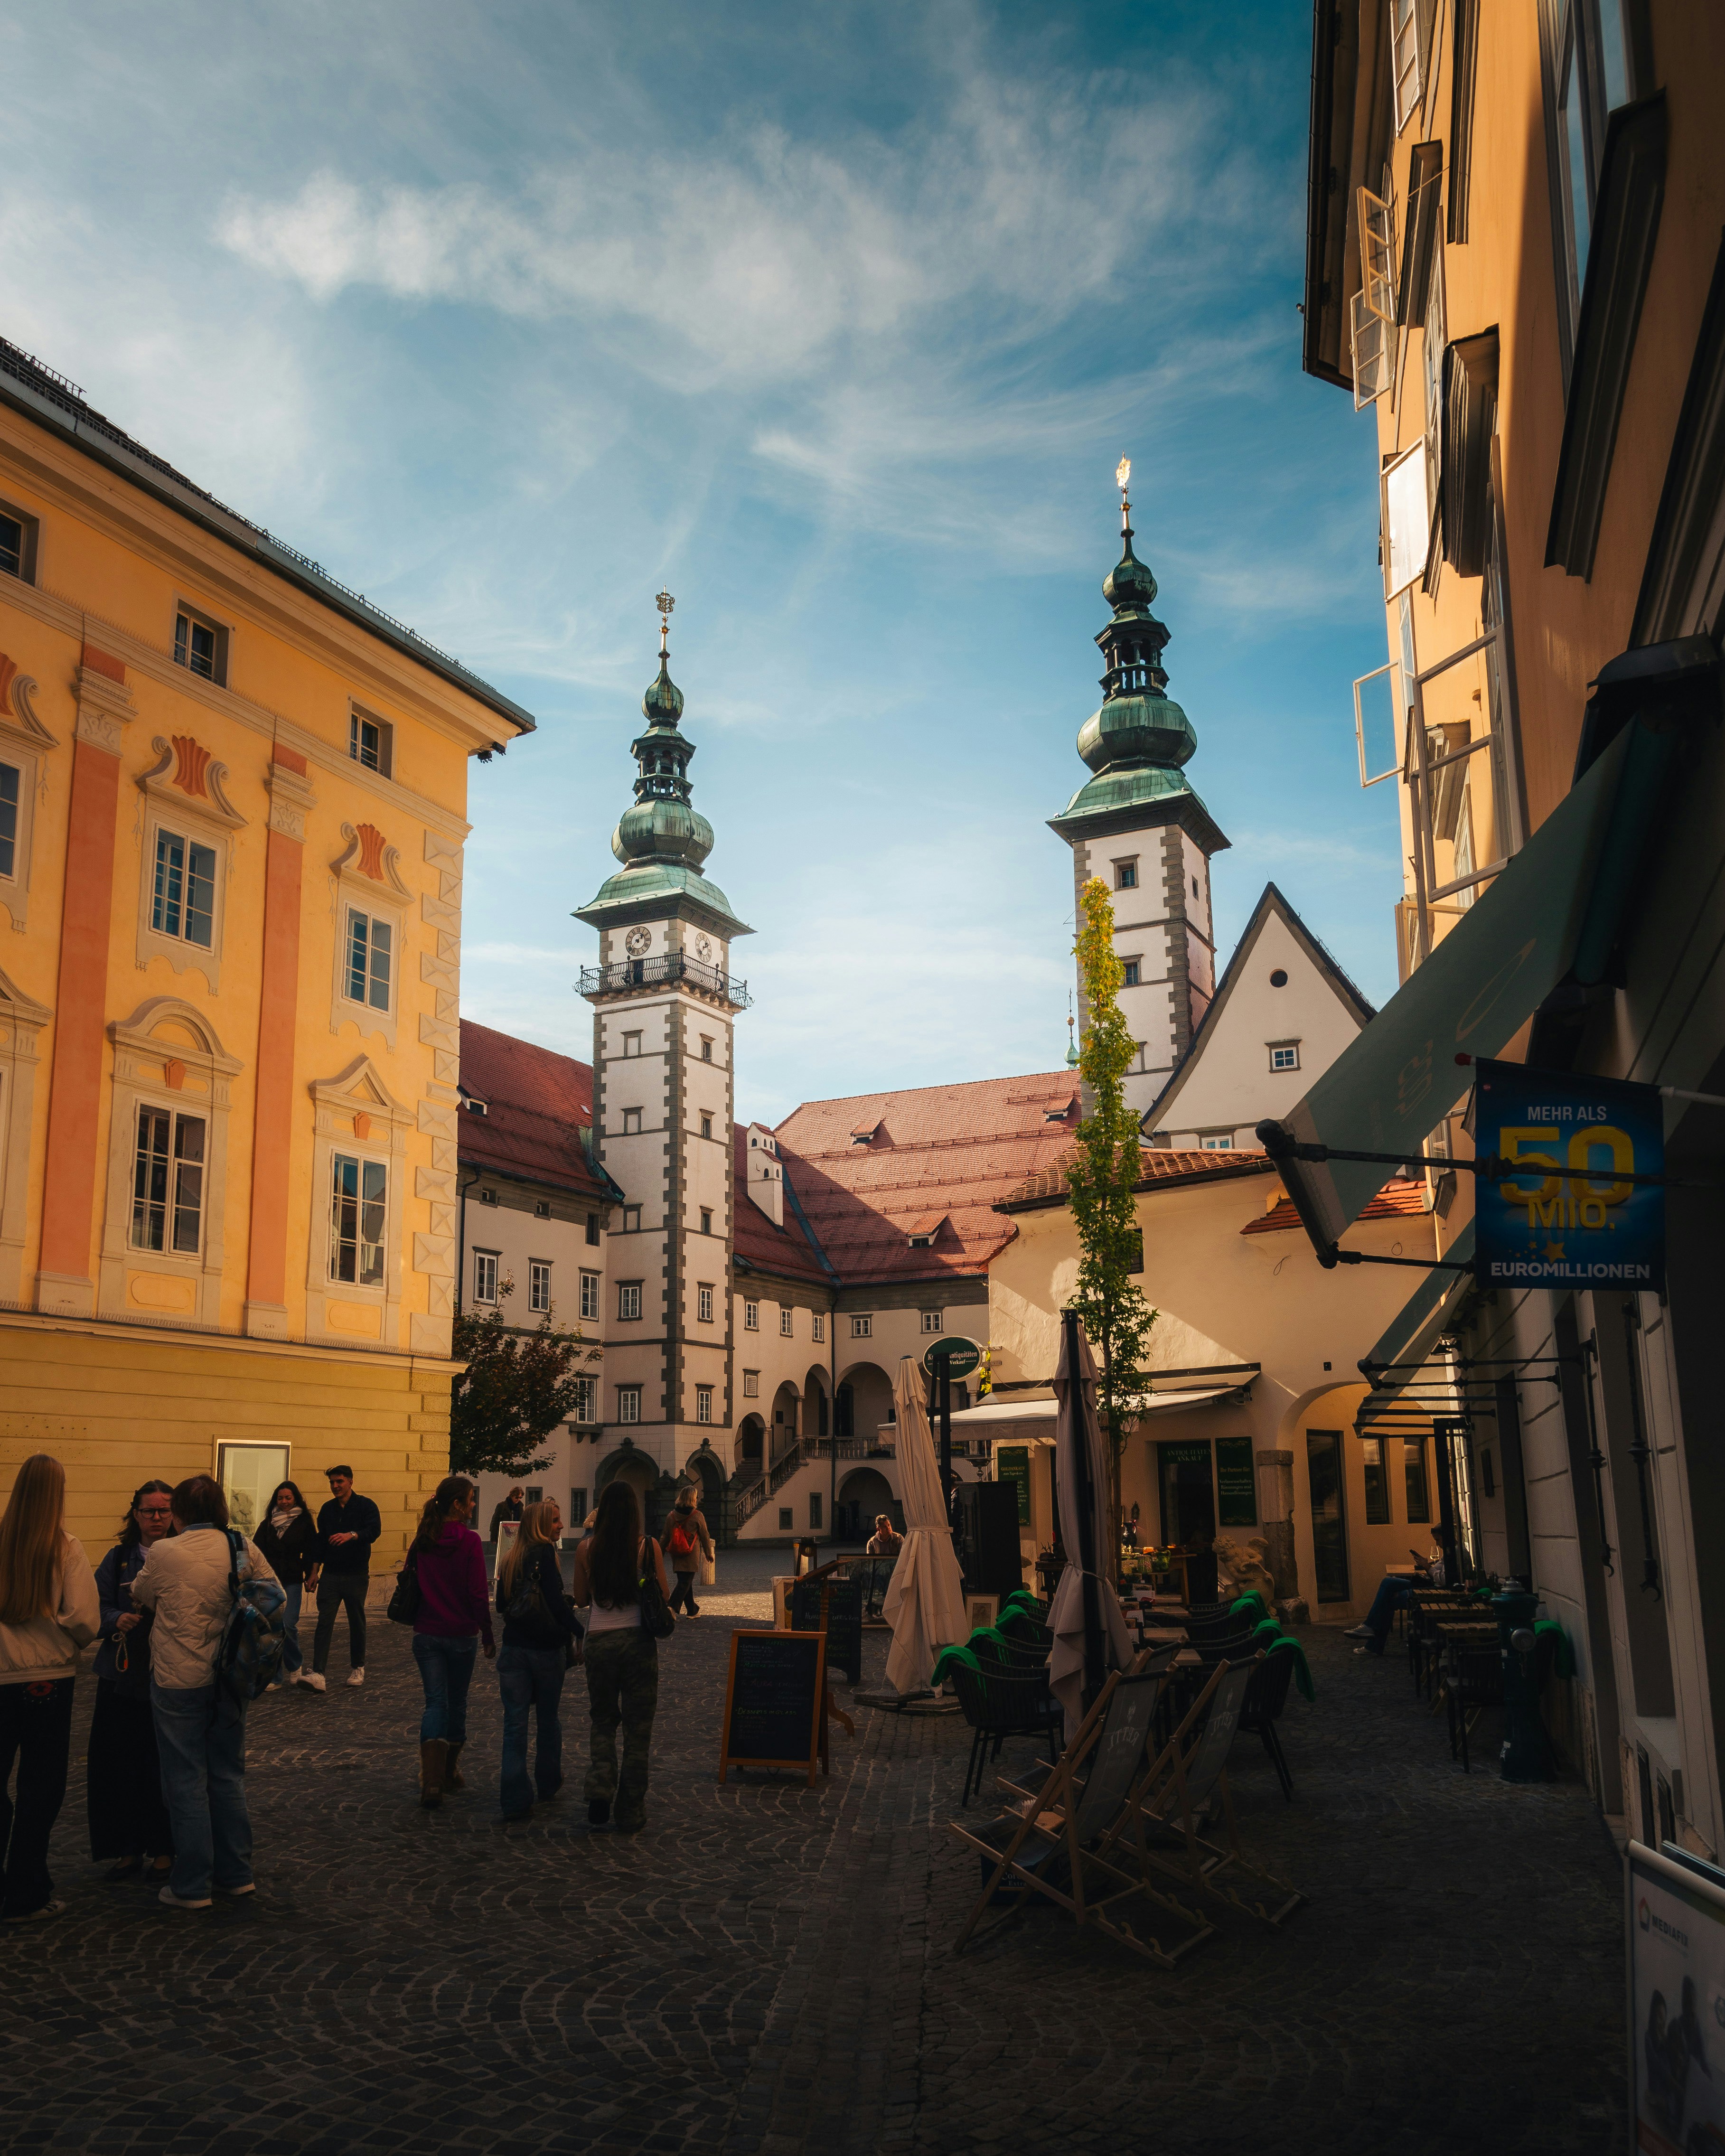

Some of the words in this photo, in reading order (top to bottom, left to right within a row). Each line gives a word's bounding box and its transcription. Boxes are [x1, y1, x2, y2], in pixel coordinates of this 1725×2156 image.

[1528, 1106, 1572, 1121] MEHR
[1576, 1106, 1607, 1121] ALS
[1499, 1125, 1634, 1205] 50
[1528, 1197, 1614, 1229] MIO.
[1491, 1262, 1650, 1279] EUROMILLIONEN
